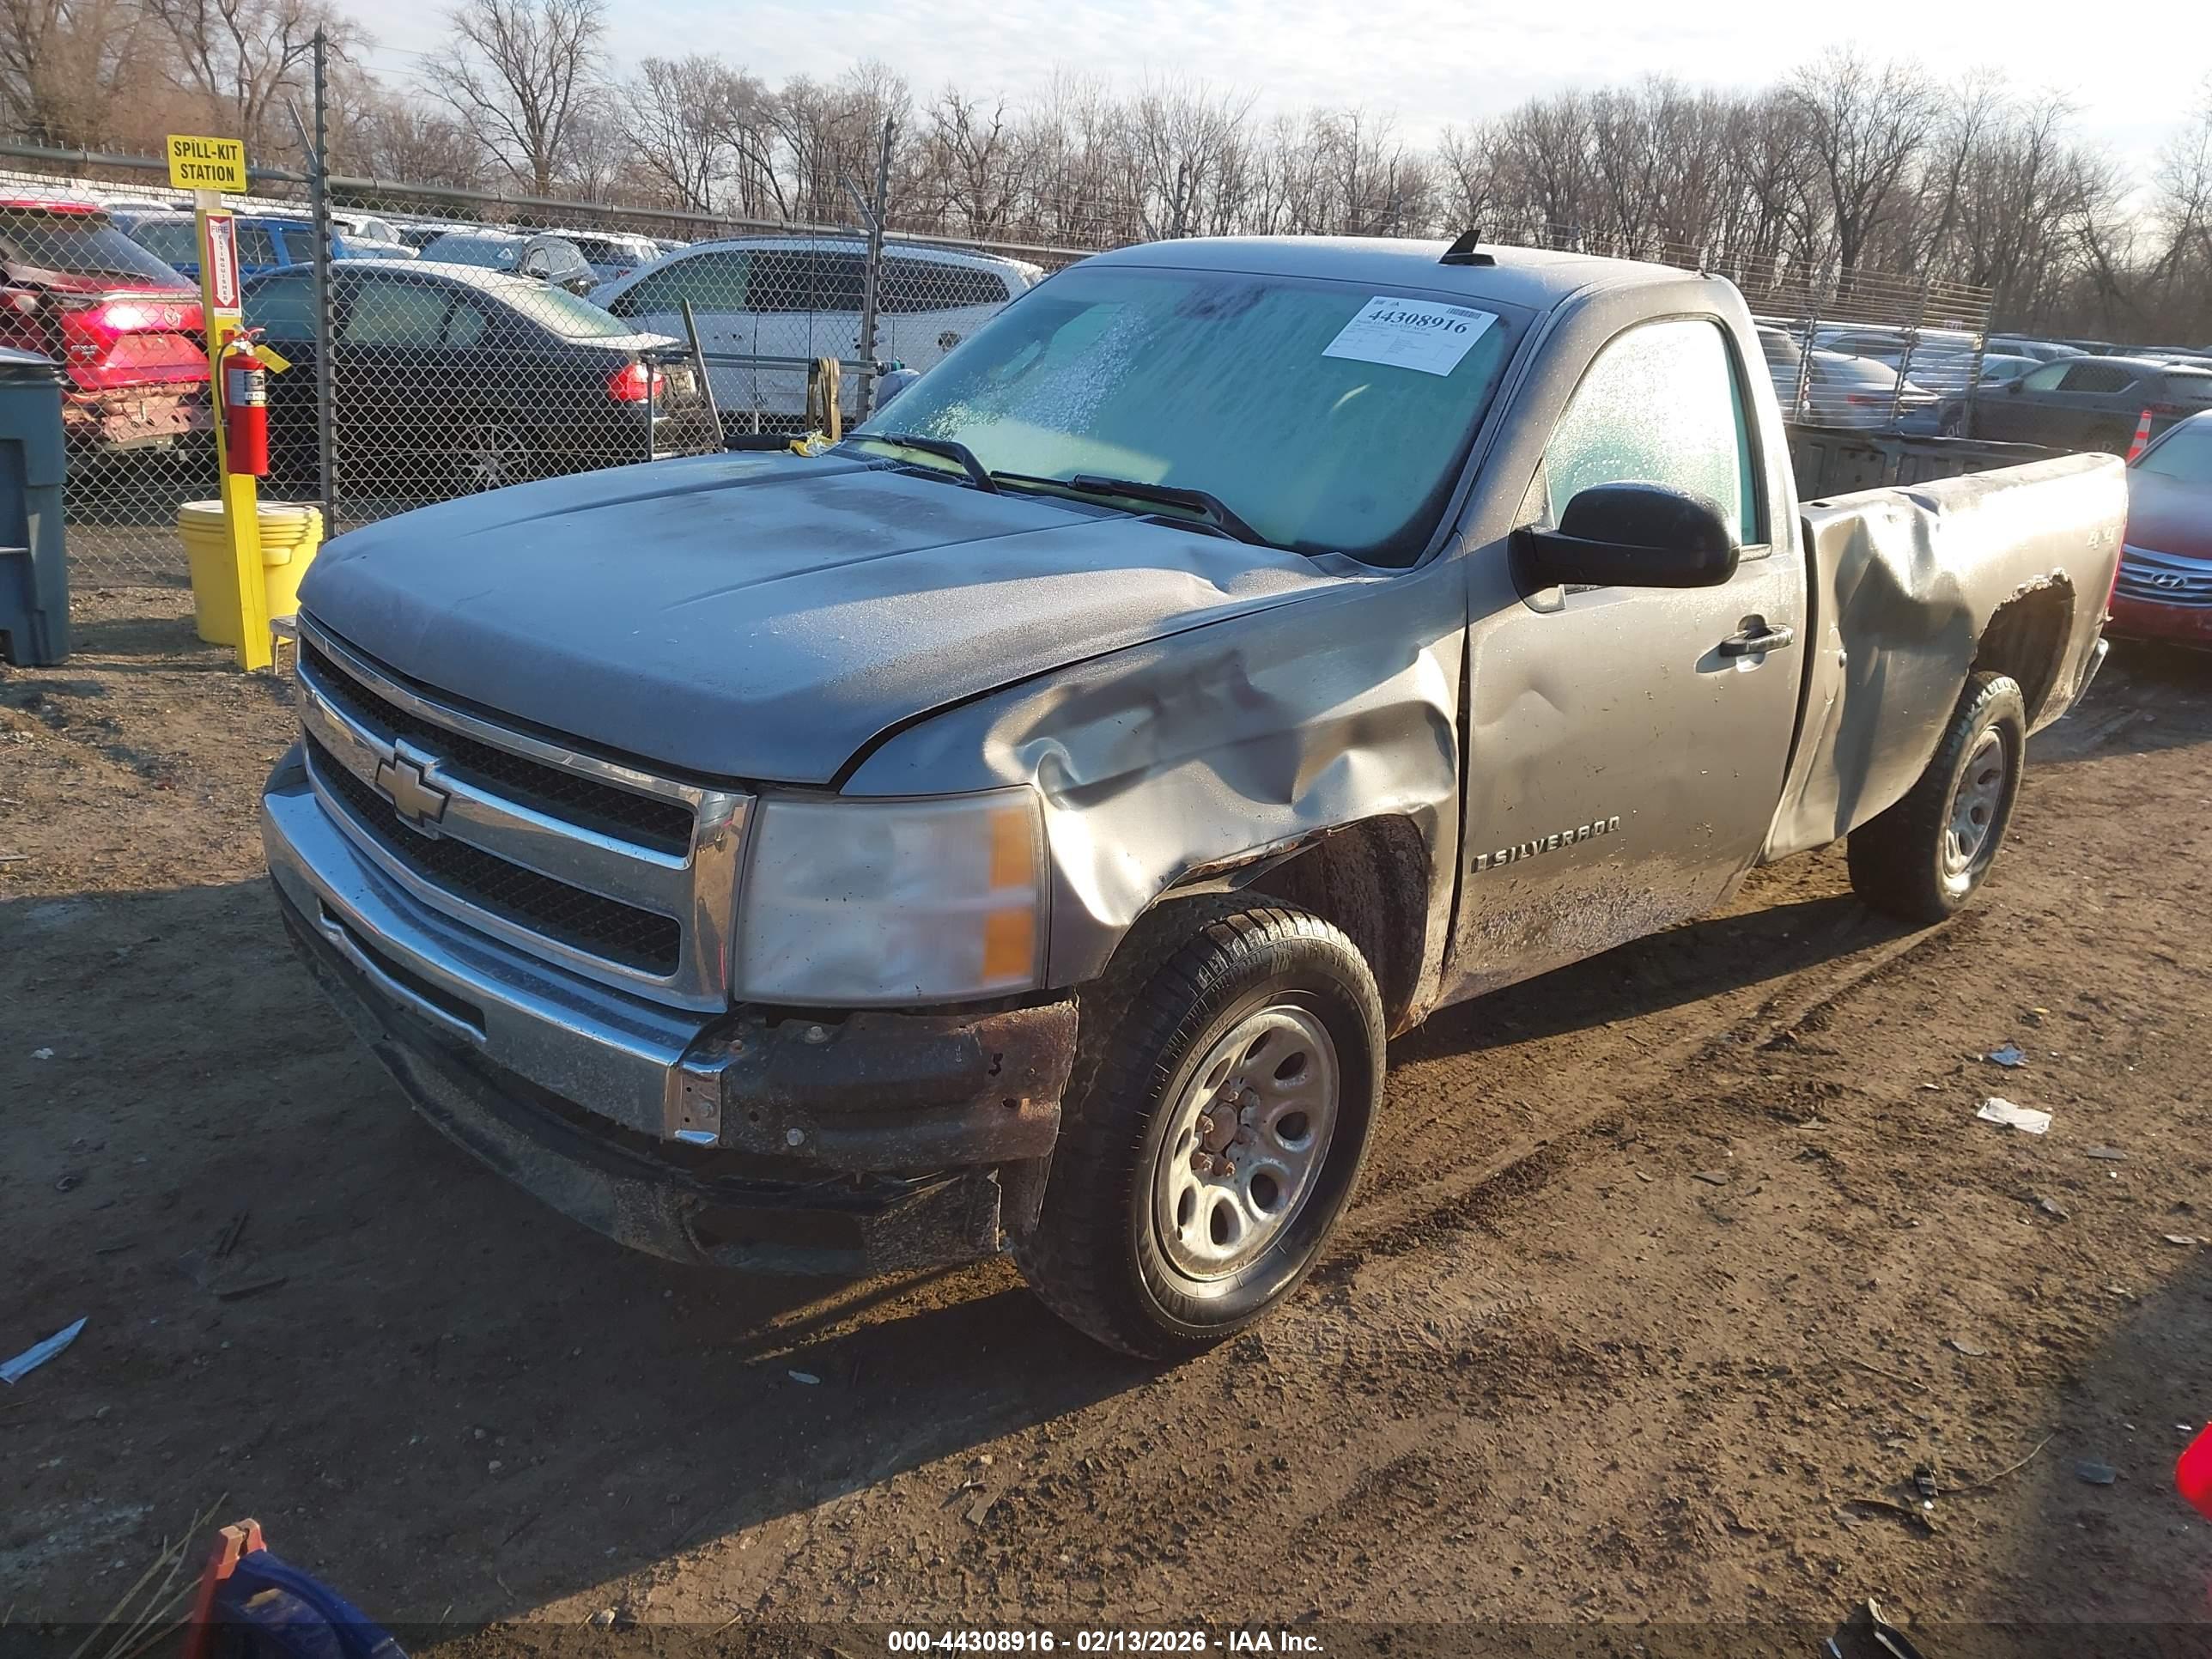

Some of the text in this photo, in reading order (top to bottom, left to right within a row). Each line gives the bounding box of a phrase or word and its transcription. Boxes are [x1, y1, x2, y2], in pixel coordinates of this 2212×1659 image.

[173, 141, 238, 161] SPILL-KIT
[180, 163, 235, 182] STATION
[210, 224, 230, 234] FIRE
[217, 234, 228, 301] EXTINGUISHER
[1367, 309, 1471, 335] 44308916
[1492, 815, 1621, 867] SILVERADO
